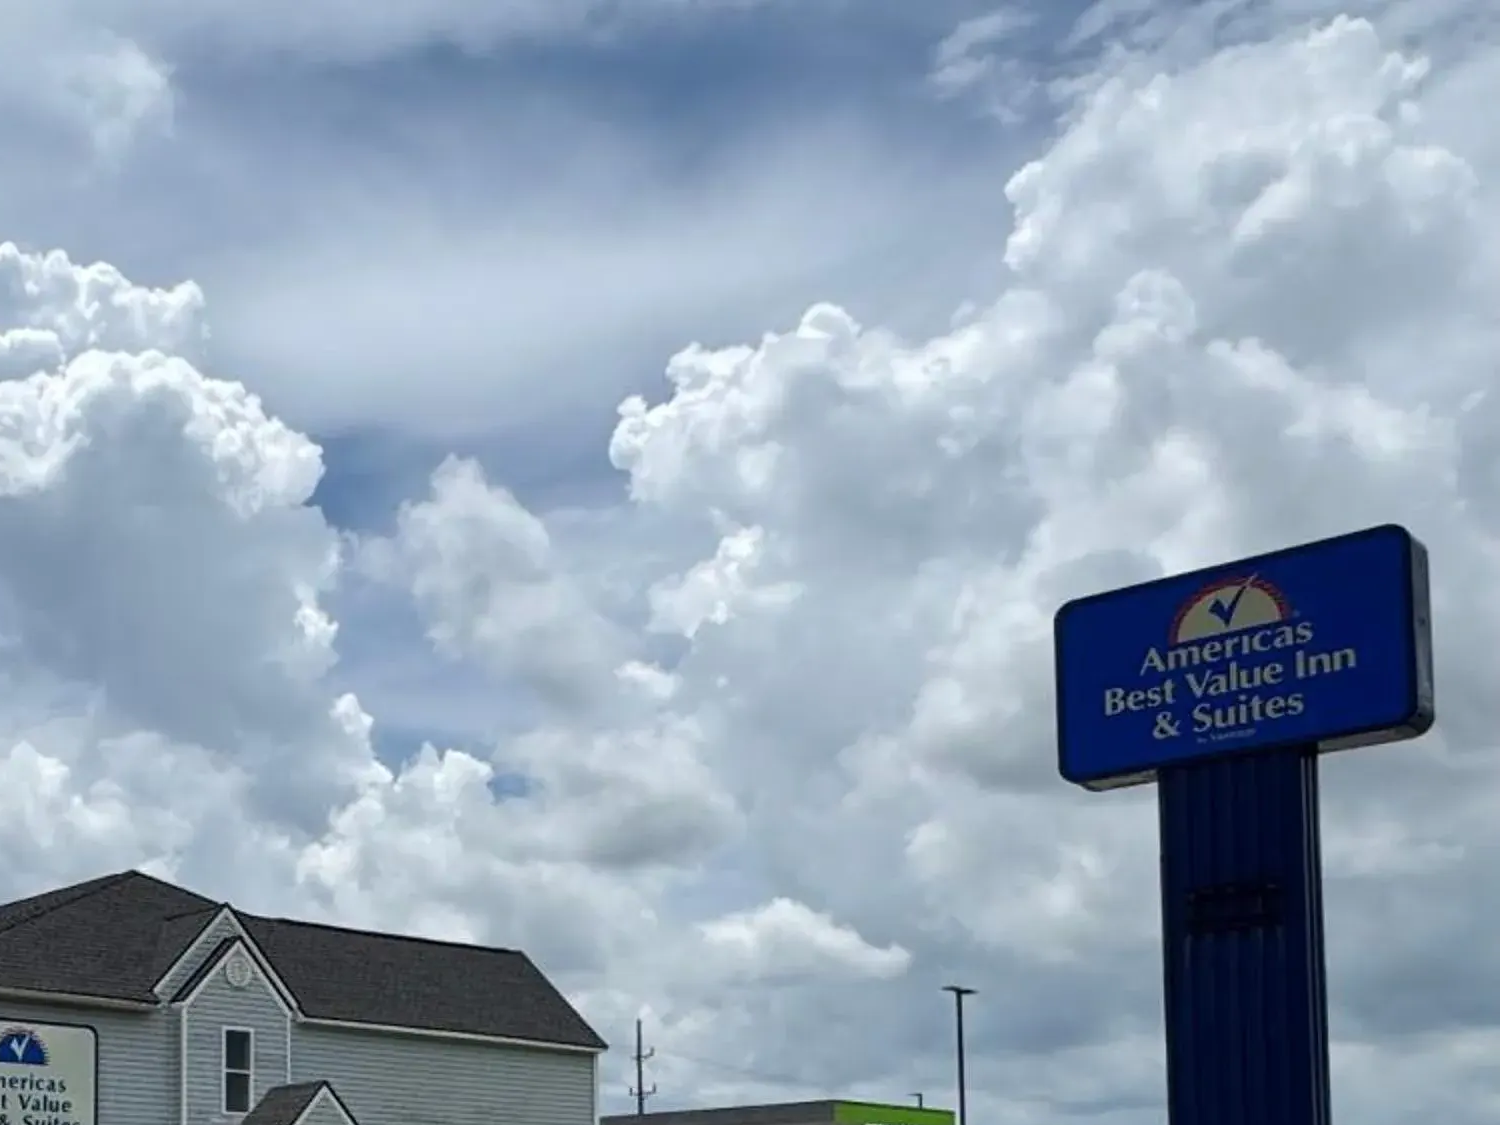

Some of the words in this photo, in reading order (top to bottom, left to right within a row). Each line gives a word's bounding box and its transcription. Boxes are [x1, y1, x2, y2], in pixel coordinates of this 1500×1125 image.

[1140, 619, 1314, 676] Americas
[1104, 680, 1175, 716] Best
[1185, 659, 1284, 700] Value
[1296, 646, 1357, 679] Inn
[1152, 710, 1182, 741] &
[1192, 691, 1305, 733] Suites
[18, 1094, 72, 1113] Value
